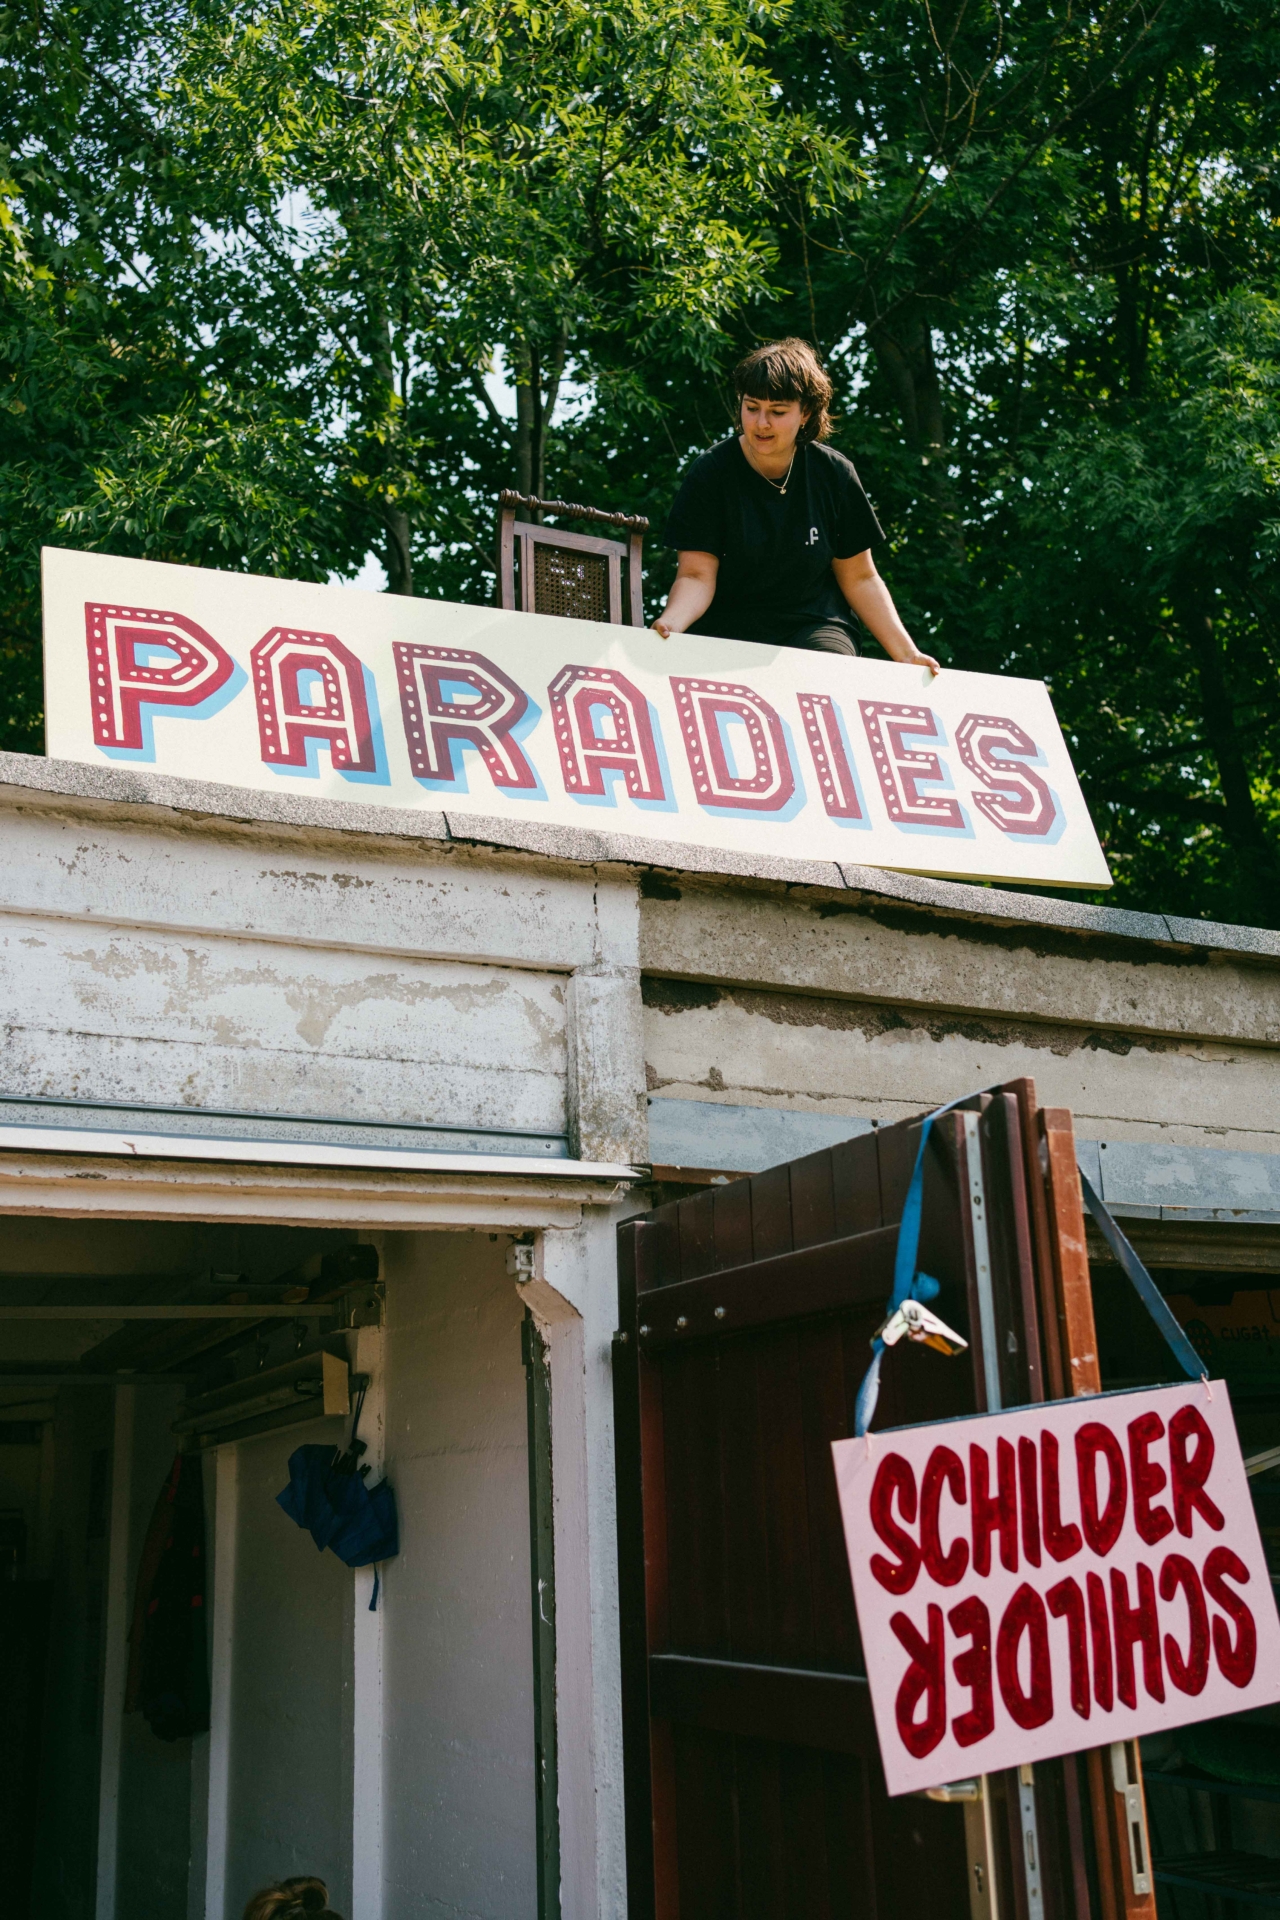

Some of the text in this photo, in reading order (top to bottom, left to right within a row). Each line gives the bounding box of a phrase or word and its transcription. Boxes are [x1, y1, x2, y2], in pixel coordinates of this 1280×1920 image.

[85, 602, 1067, 844] PARADIES
[870, 1404, 1225, 1595] SCHILDER
[889, 1545, 1257, 1759] SCHILDER
